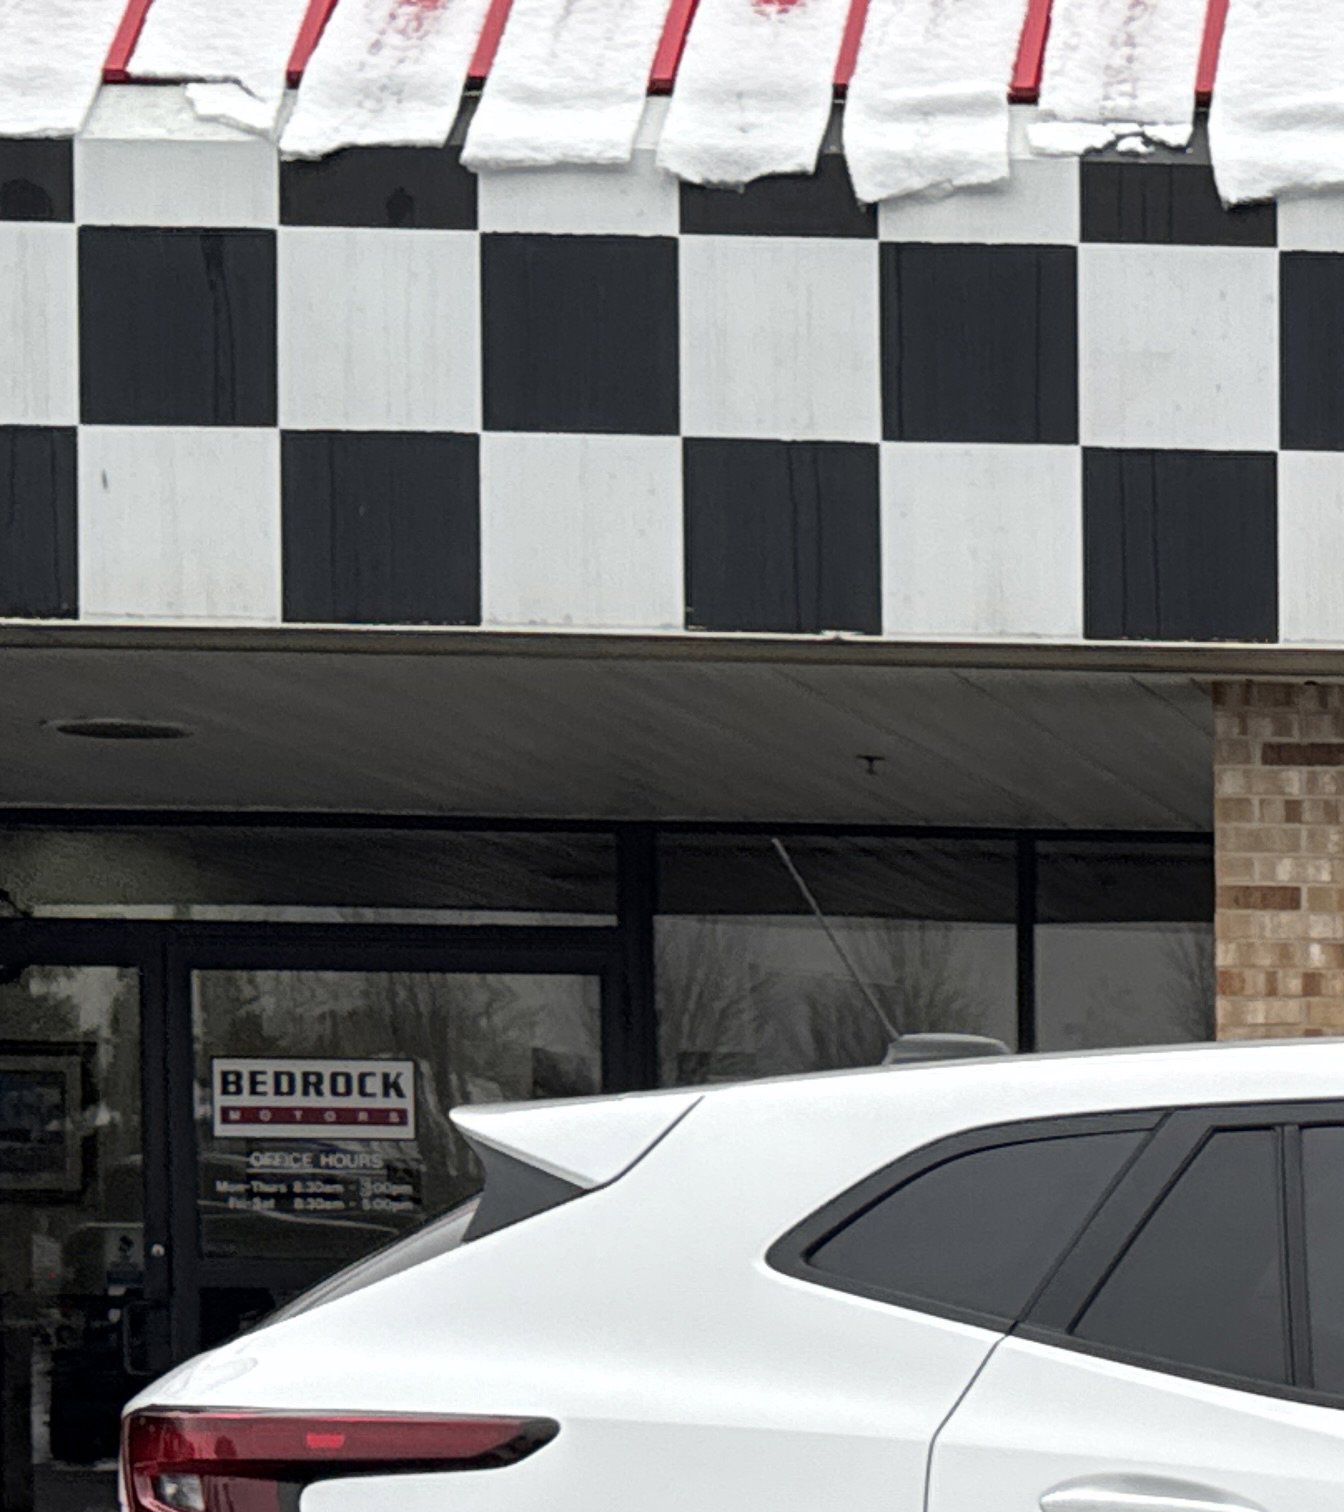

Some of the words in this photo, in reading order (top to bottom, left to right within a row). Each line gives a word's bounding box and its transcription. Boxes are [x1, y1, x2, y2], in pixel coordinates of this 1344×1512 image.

[220, 1070, 406, 1099] BEDROCK
[228, 1109, 400, 1123] MOTORS
[250, 1152, 314, 1168] OFFICE
[319, 1153, 384, 1169] HOURS
